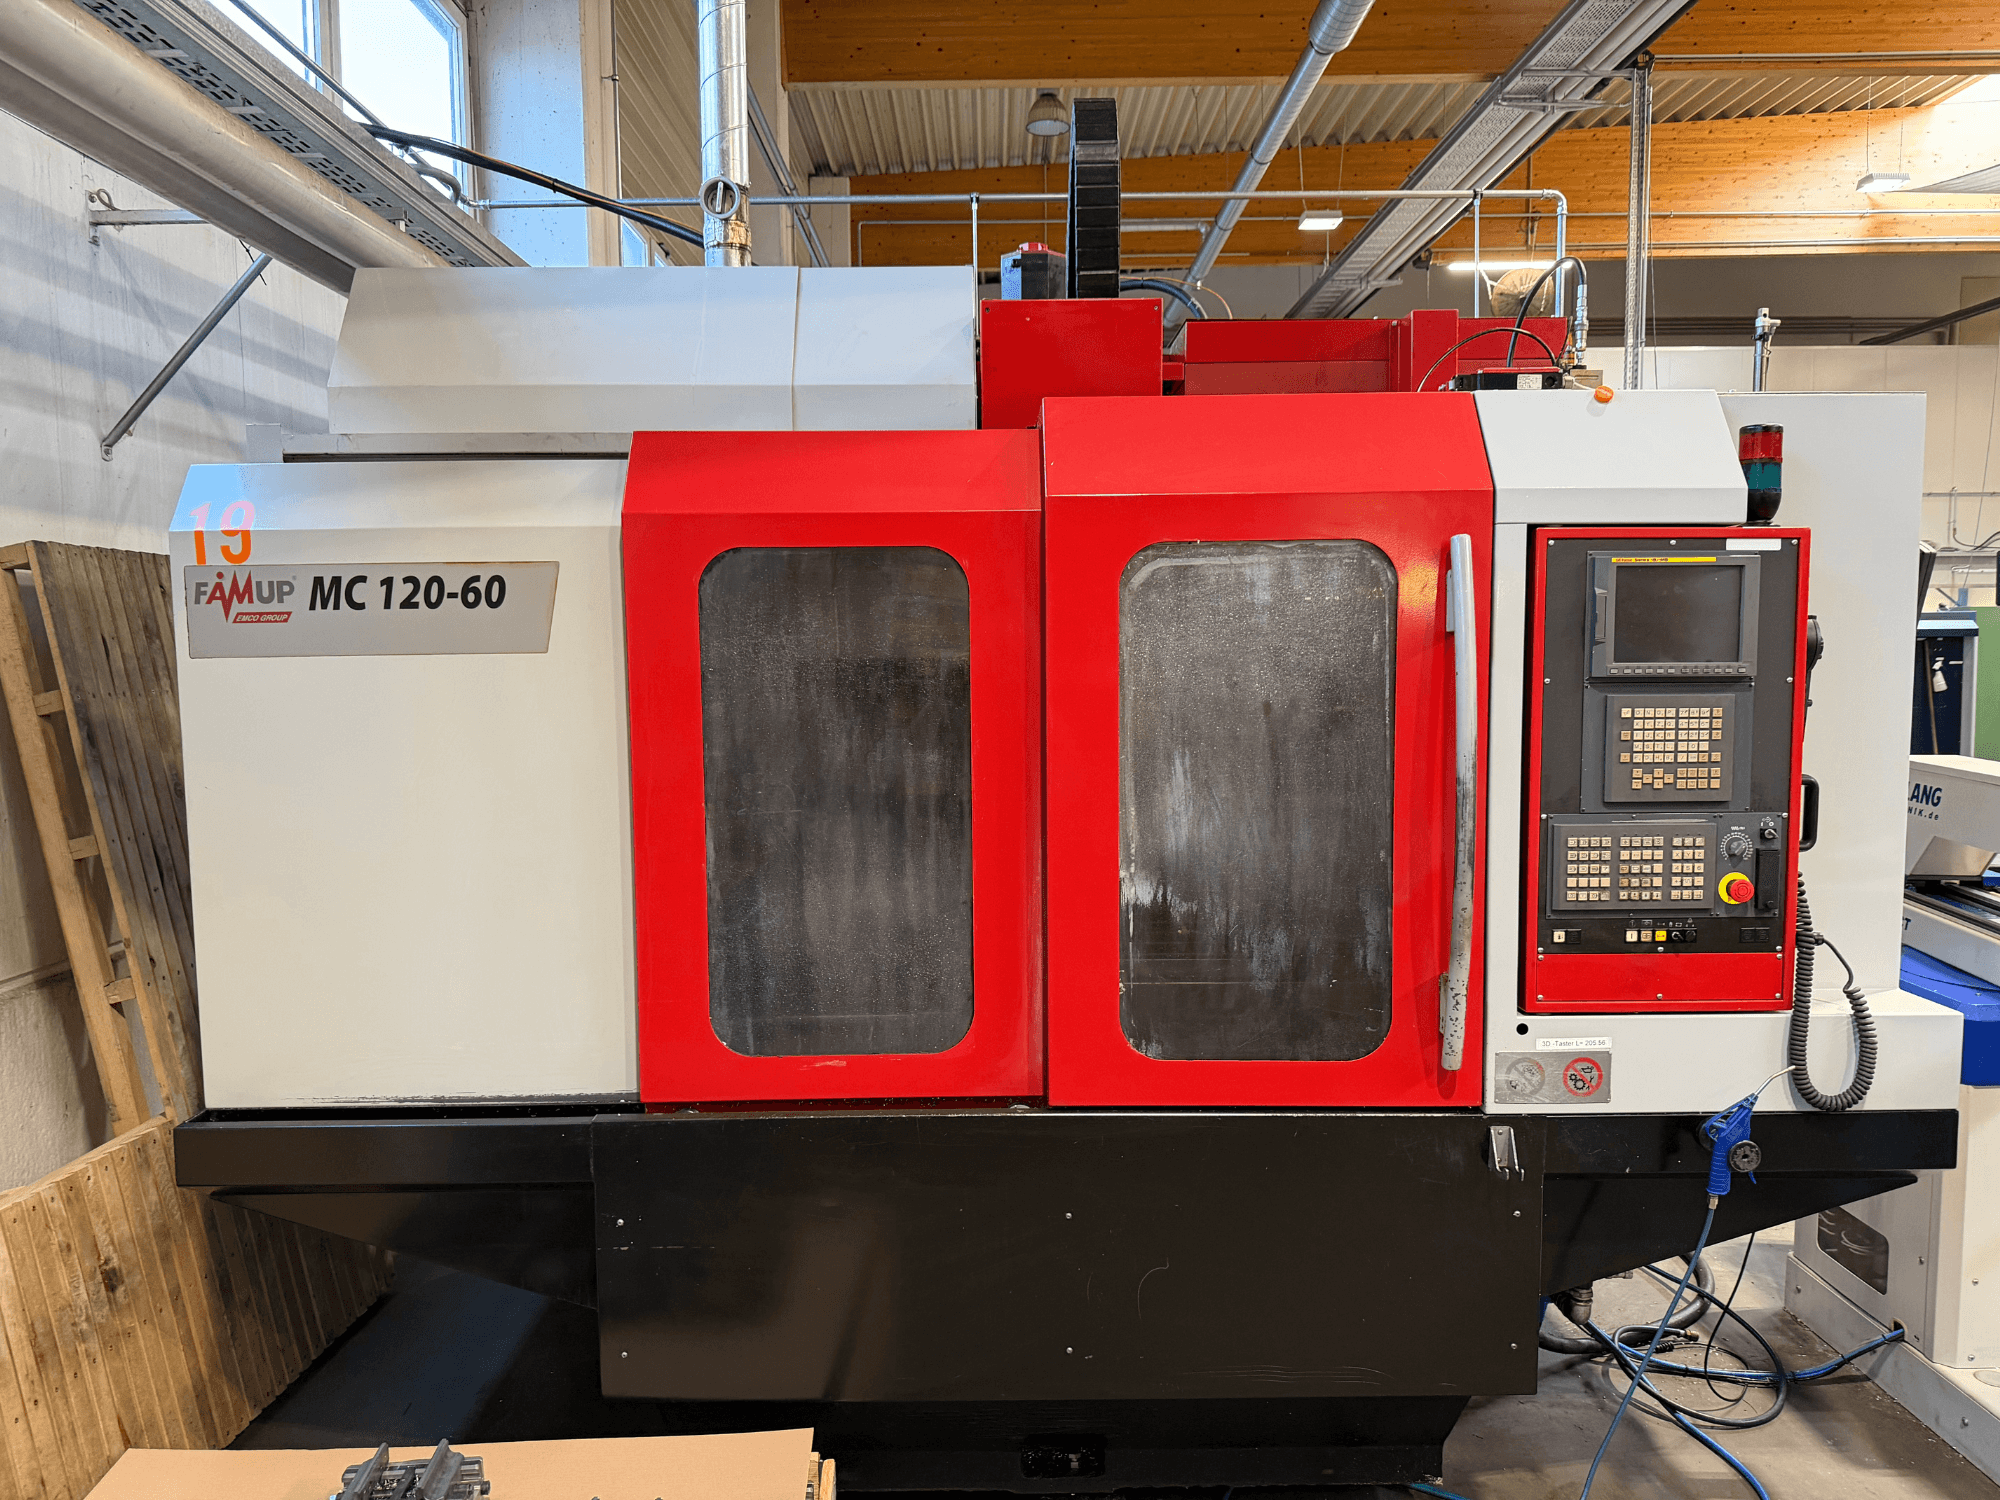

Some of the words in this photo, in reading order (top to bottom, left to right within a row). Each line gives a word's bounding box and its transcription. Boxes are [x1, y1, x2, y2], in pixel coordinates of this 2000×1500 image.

[189, 500, 256, 566] 19
[308, 575, 367, 611] MC
[378, 574, 507, 611] 120-60
[236, 614, 260, 623] EMCO
[260, 613, 289, 622] GROUP
[1908, 781, 1943, 807] ANG
